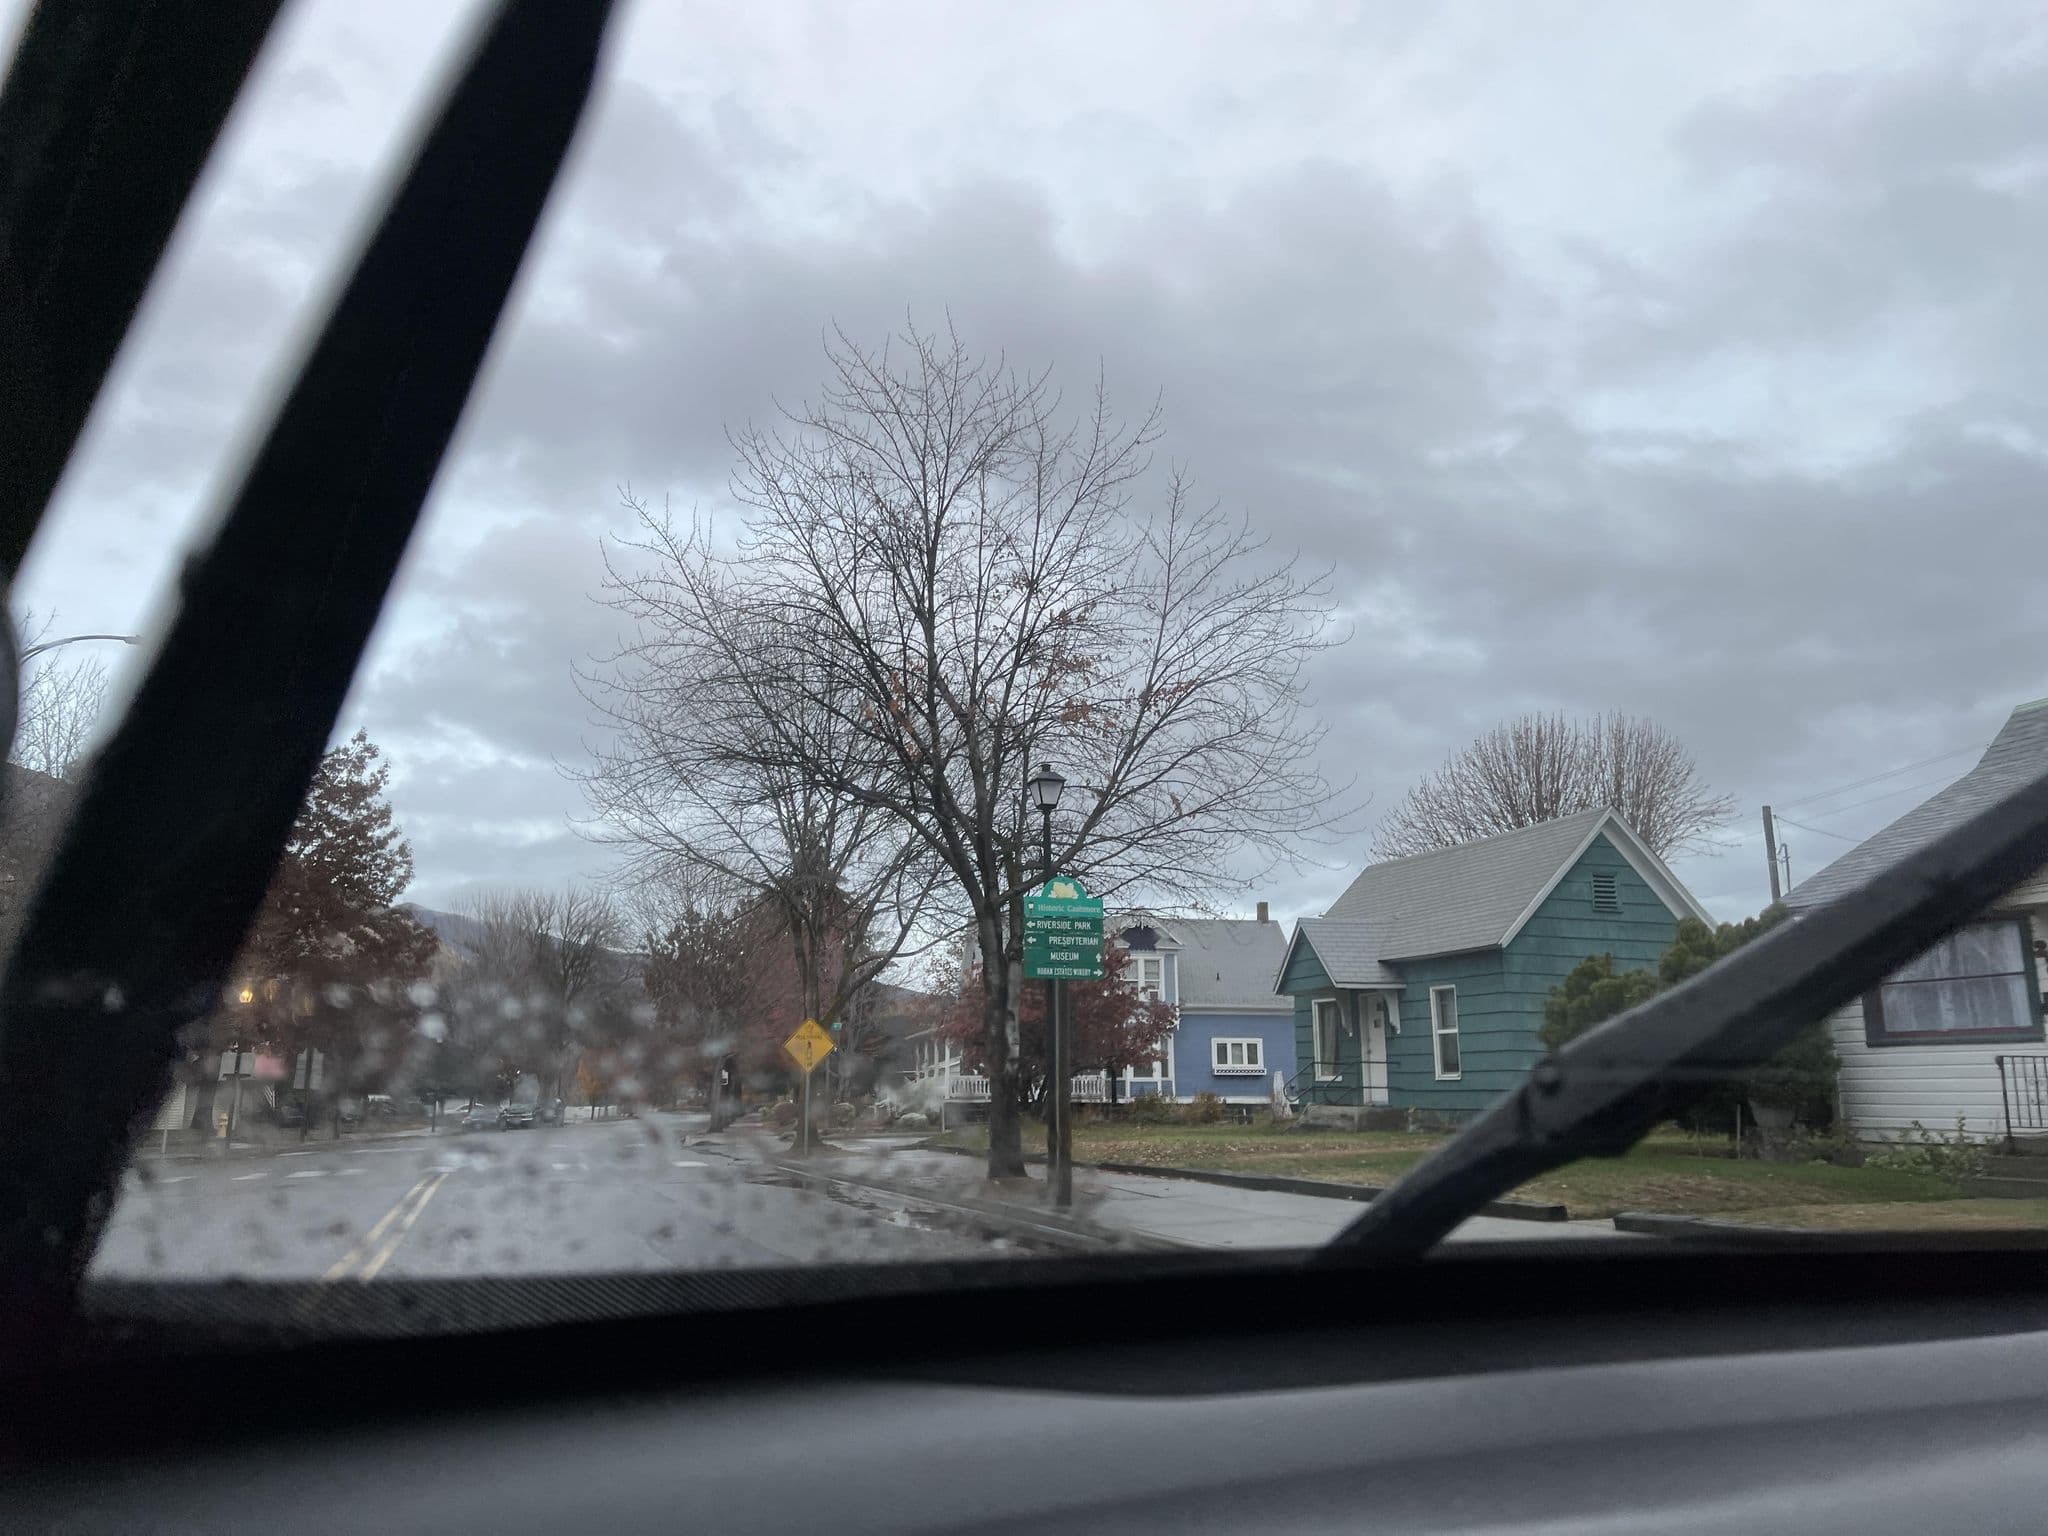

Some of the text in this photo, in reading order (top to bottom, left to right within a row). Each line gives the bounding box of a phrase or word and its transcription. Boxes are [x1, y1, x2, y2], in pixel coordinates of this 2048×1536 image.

[1036, 920, 1091, 930] RIVERSIDE PARK
[1049, 936, 1098, 945] PRESBYTERIAN
[1050, 952, 1079, 960] MUSEUM
